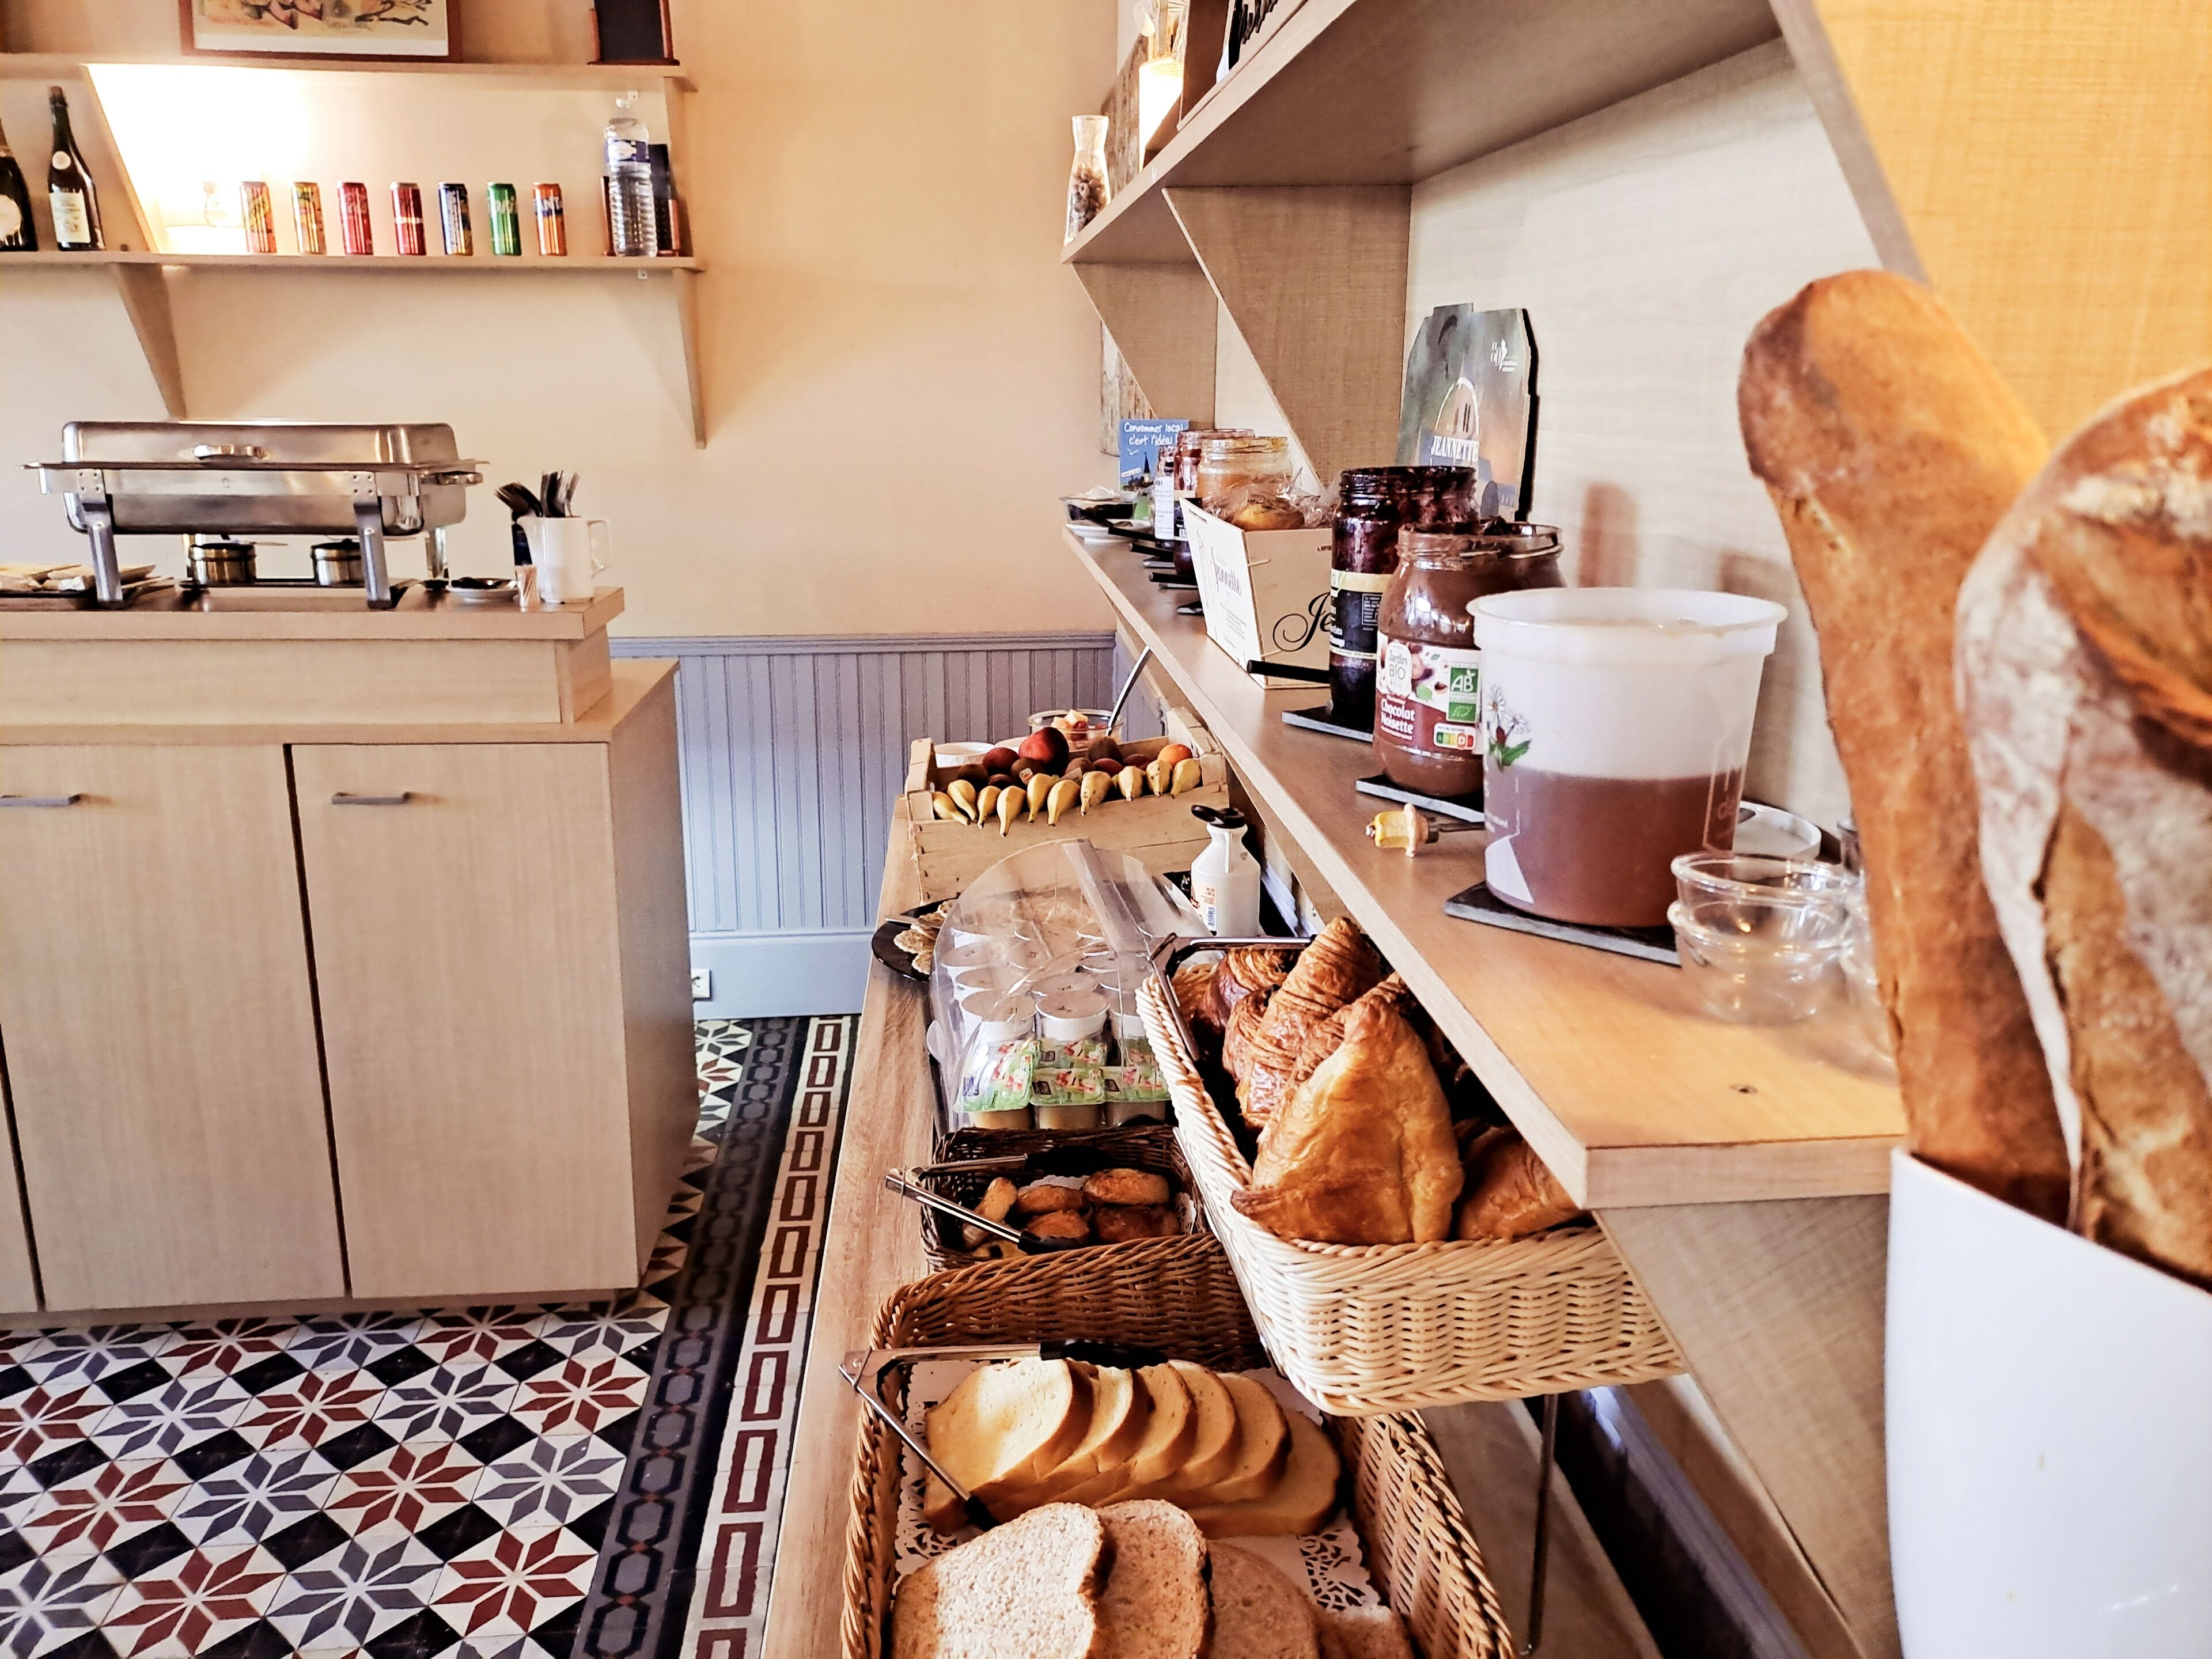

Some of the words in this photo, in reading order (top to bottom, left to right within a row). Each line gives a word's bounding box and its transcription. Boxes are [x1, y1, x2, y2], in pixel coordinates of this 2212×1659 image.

[1124, 422, 1162, 433] Consommer
[1165, 423, 1184, 433] local
[1128, 434, 1149, 445] c'est
[1431, 435, 1480, 461] JEANNETTE
[1273, 592, 1330, 652] Je
[1388, 650, 1408, 666] Jardin
[1450, 674, 1474, 692] AB
[1381, 698, 1416, 721] Chocolat
[1381, 711, 1414, 734] Noisette
